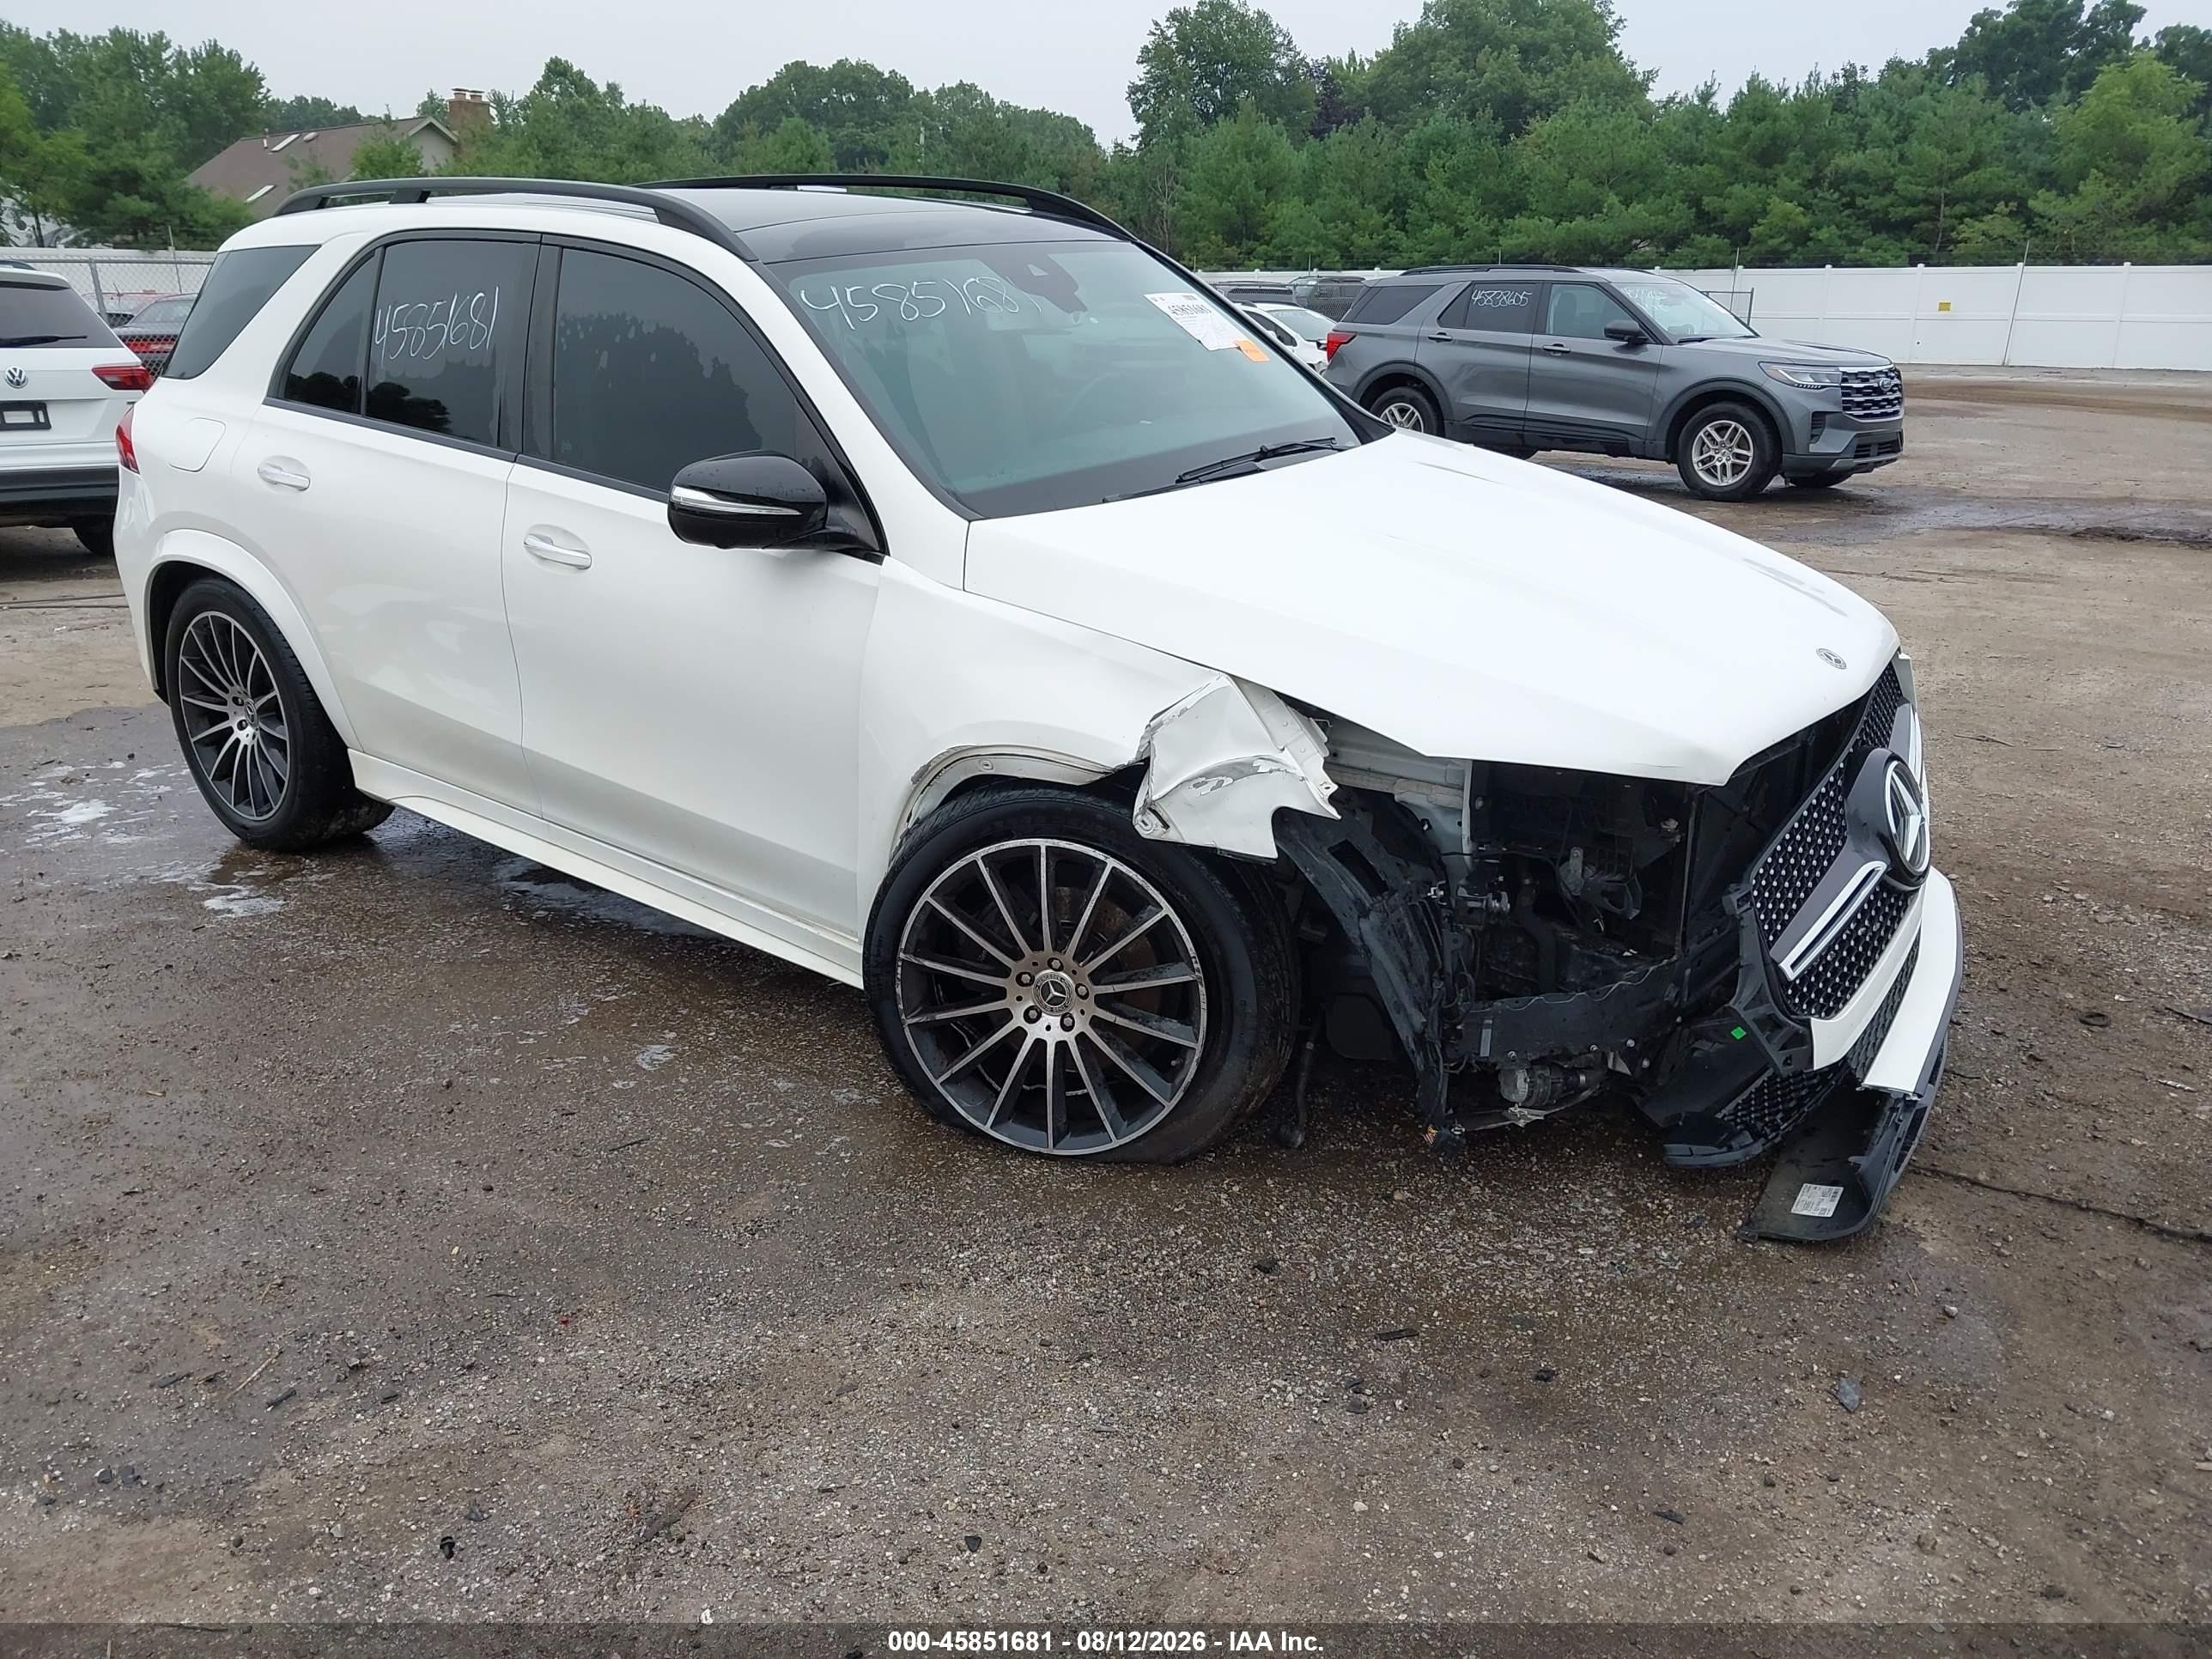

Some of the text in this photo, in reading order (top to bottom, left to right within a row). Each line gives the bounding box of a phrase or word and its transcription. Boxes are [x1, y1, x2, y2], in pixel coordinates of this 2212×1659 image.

[799, 276, 1042, 331] 45851681
[1471, 289, 1533, 307] 45838605
[374, 286, 499, 369] 45851681
